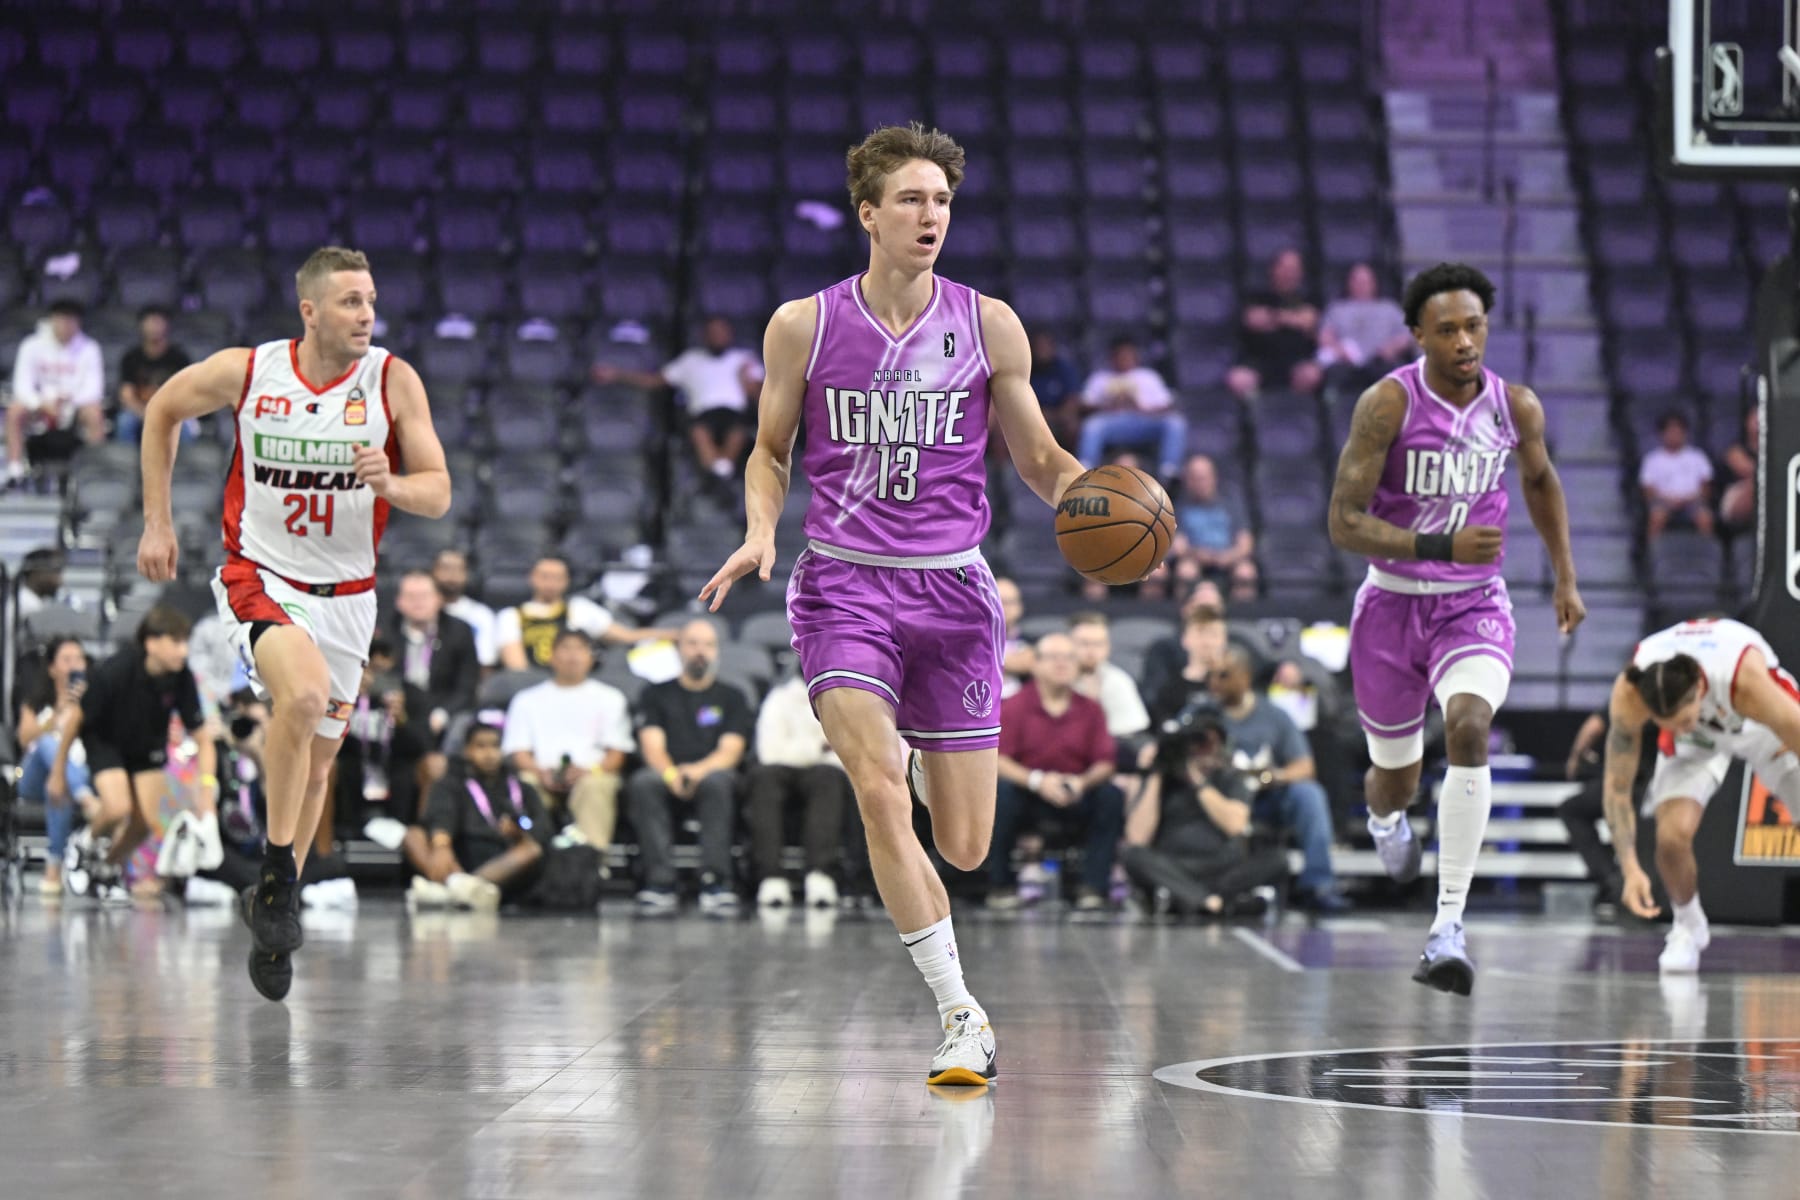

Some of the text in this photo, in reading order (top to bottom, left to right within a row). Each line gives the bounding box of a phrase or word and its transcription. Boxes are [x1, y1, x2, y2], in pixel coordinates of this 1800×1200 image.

[825, 387, 970, 446] IGNITE
[253, 462, 365, 490] WILDCAT
[874, 445, 920, 502] 13
[1405, 449, 1510, 496] IGNITE
[283, 493, 334, 537] 24
